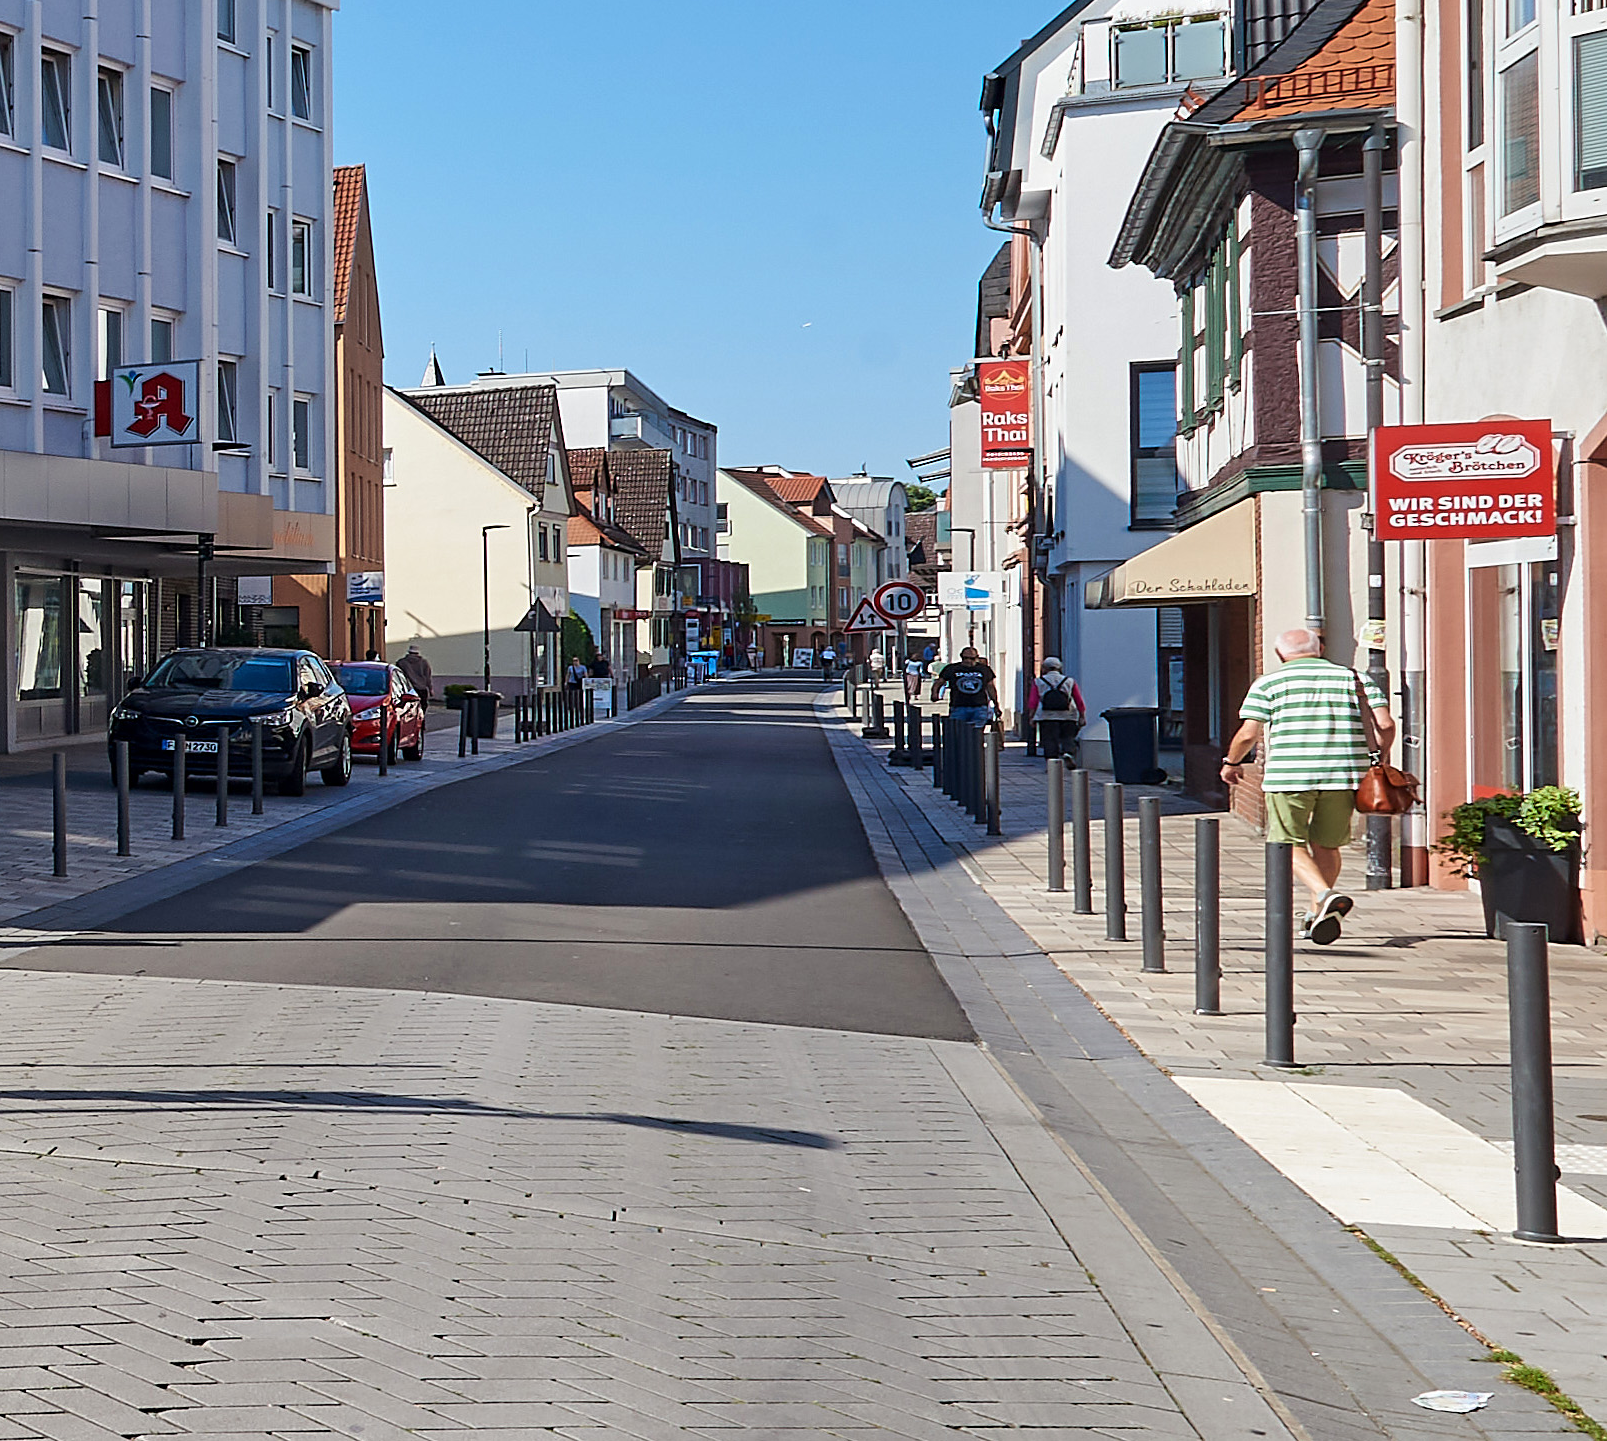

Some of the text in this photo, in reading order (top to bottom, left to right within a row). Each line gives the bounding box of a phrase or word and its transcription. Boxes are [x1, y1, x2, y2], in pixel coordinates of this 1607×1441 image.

[982, 411, 1028, 425] Raks
[983, 426, 1027, 442] Thai
[1403, 451, 1472, 465] Kröger's
[1448, 461, 1526, 473] Brötchen
[1388, 494, 1543, 512] WIR SIND DER
[1389, 510, 1543, 527] GESCHMACK!
[1129, 580, 1163, 593] Der
[887, 593, 912, 611] 10
